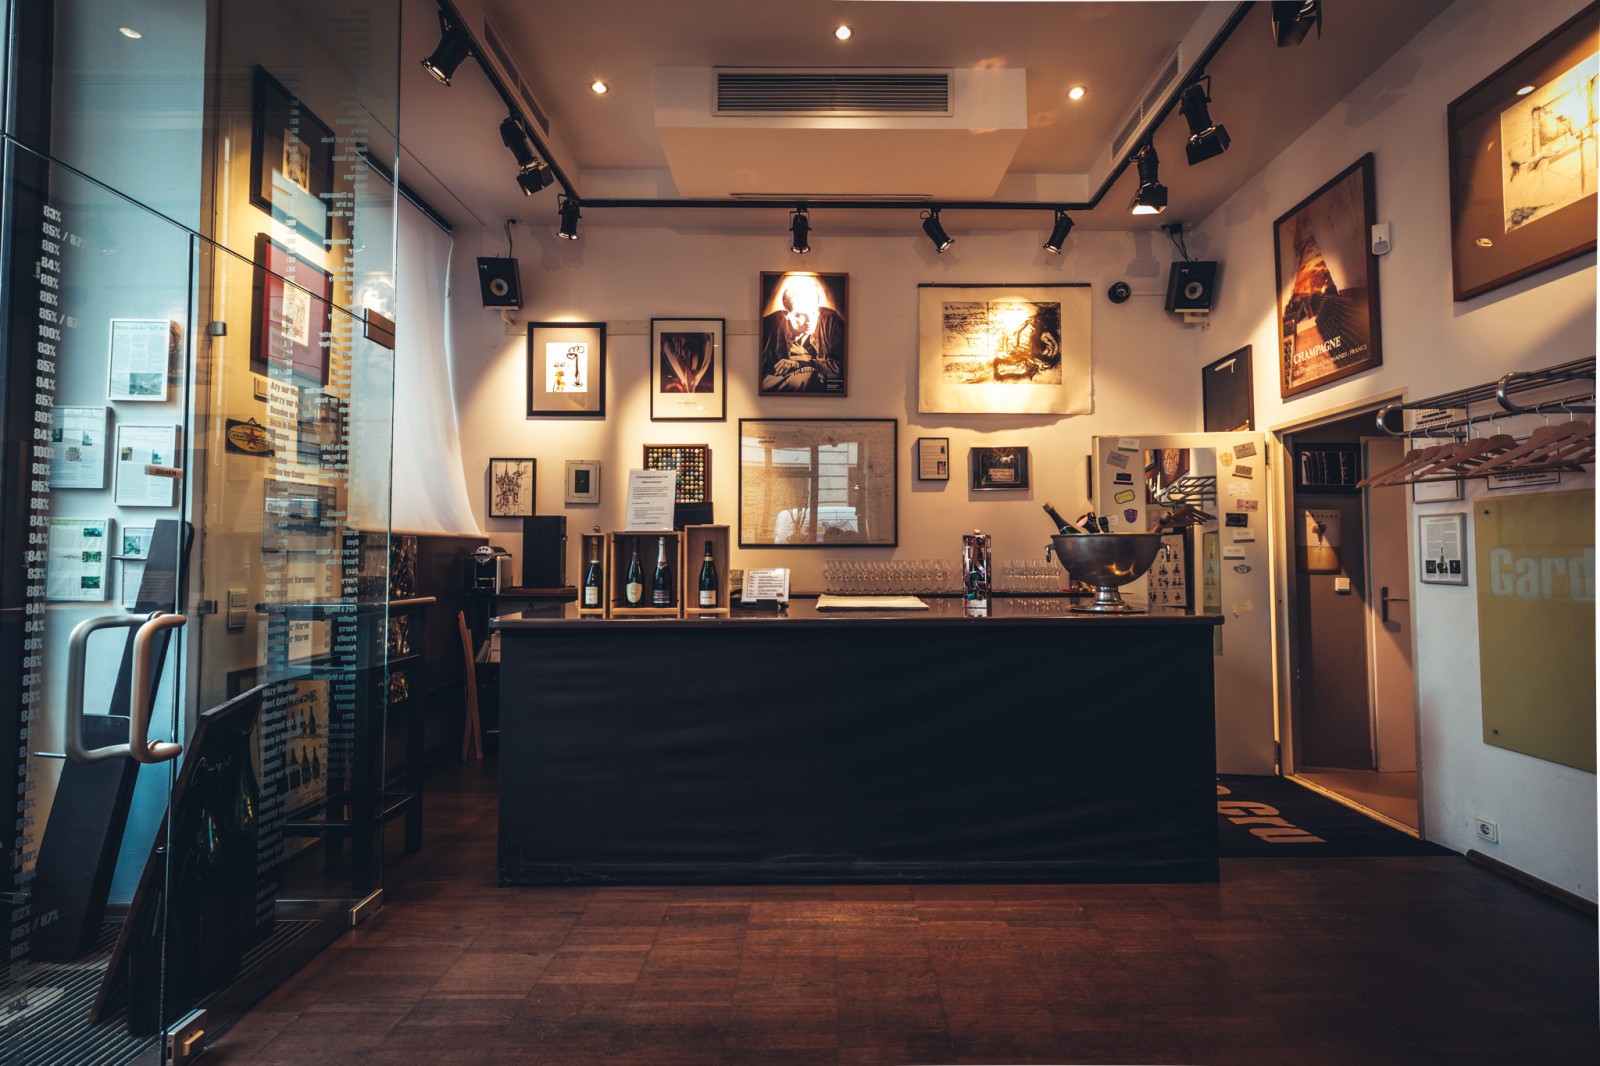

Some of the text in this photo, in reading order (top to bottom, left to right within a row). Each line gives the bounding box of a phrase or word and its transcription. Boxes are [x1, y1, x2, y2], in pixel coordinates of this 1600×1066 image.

[44, 205, 62, 222] 83%
[42, 222, 60, 240] 85%
[42, 239, 60, 256] 86%
[41, 256, 60, 273] 84%
[40, 290, 58, 306] 86%
[38, 324, 61, 341] 100%
[38, 342, 56, 356] 83%
[1293, 335, 1341, 364] CHAMPAGNE
[36, 359, 56, 374] 85%
[270, 381, 280, 393] Azy
[33, 428, 53, 442] 84%
[33, 445, 56, 460] 100%
[155, 468, 177, 477] ZIEHEN
[1489, 547, 1595, 600] Gard
[26, 602, 46, 615] 84%
[24, 619, 44, 632] 84%
[294, 622, 310, 630] Marne
